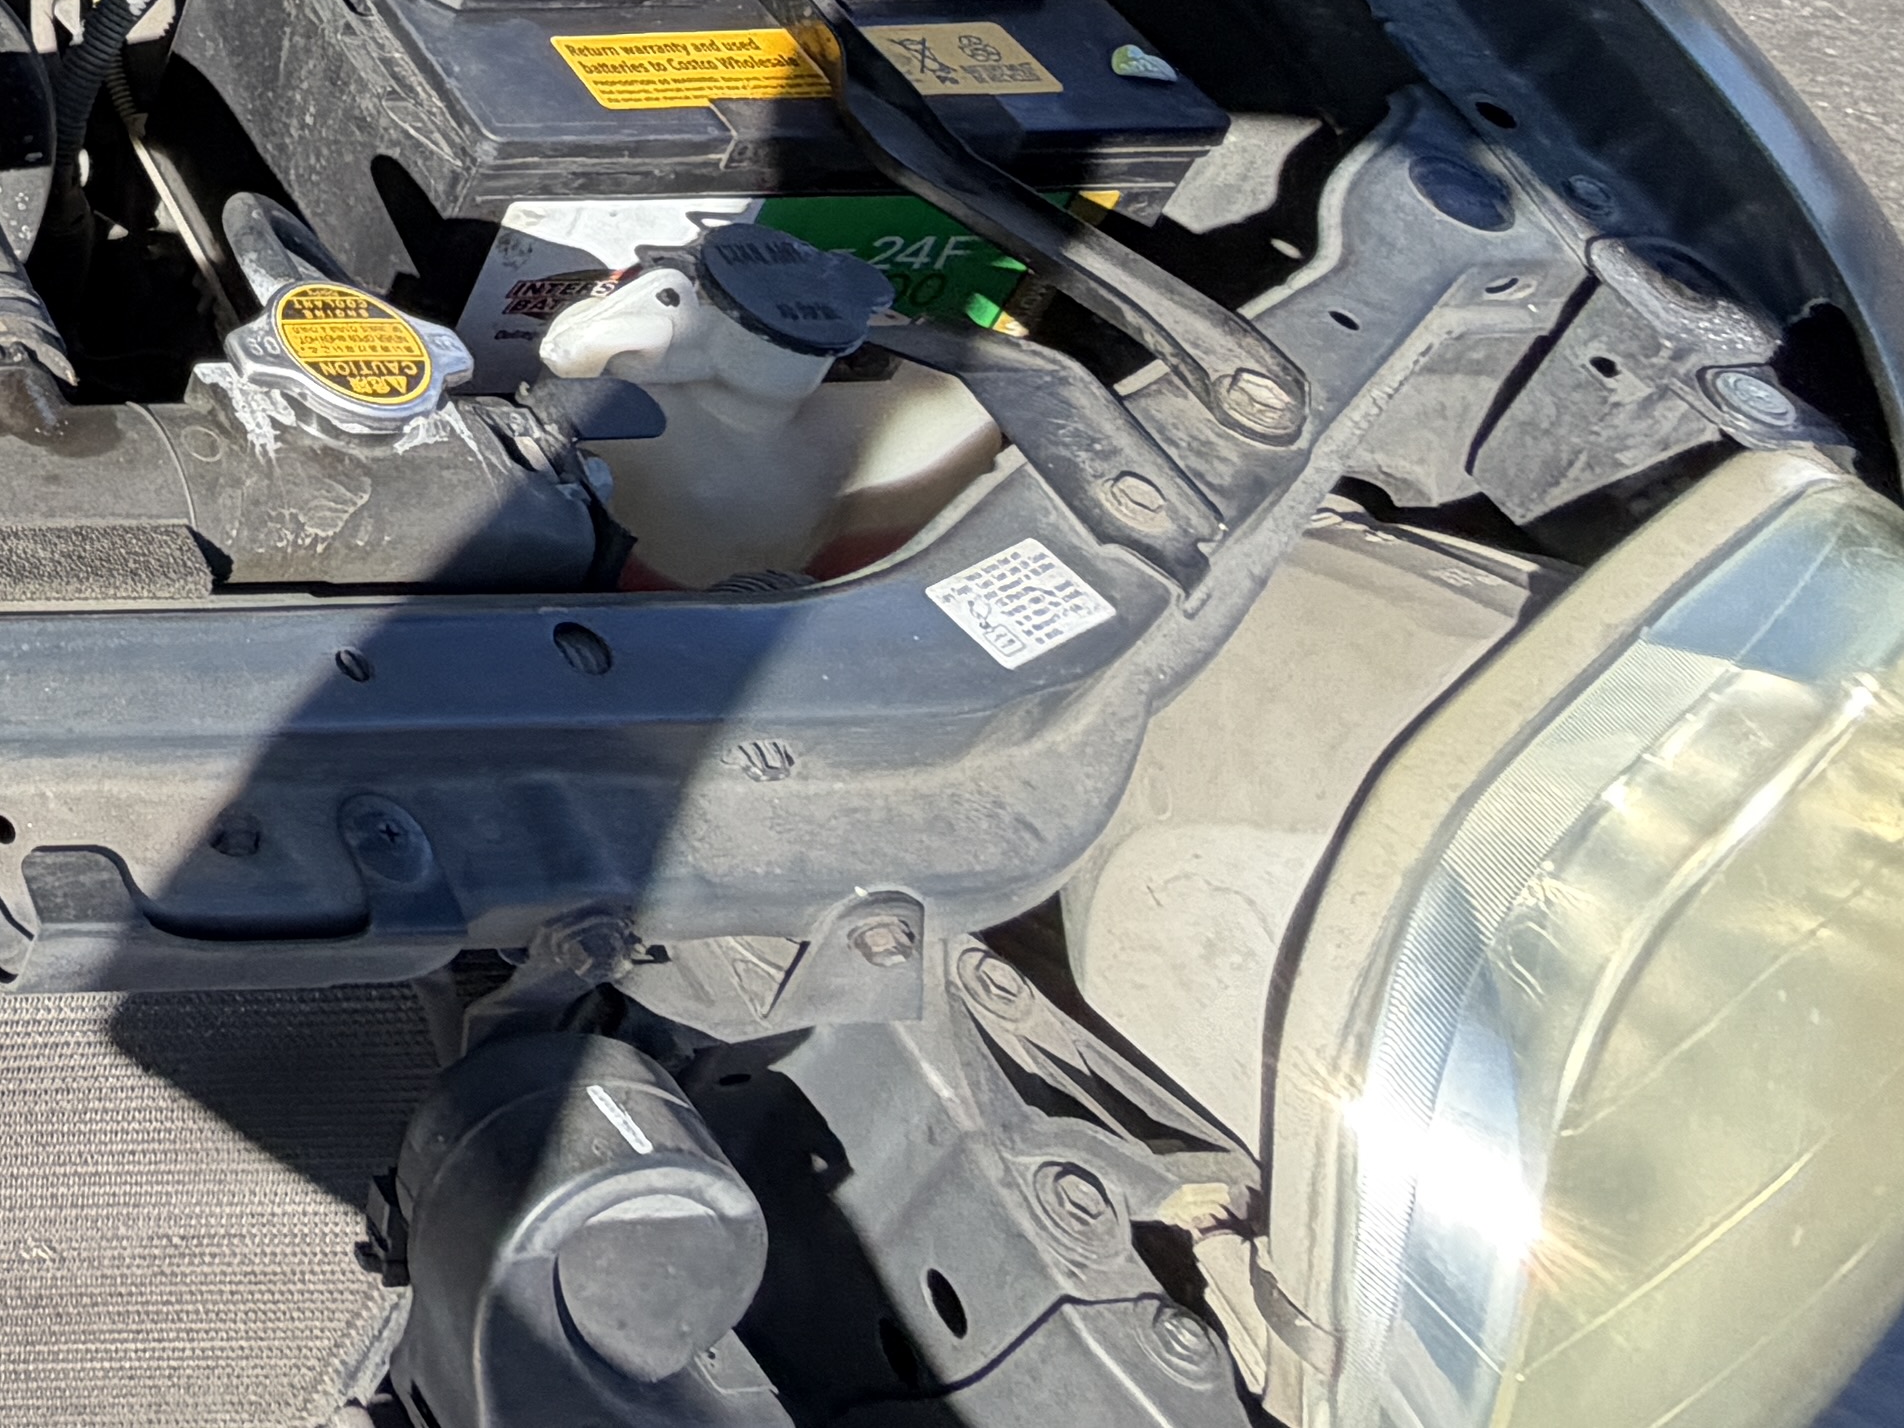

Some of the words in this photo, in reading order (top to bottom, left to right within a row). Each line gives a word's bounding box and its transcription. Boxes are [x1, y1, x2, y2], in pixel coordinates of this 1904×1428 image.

[565, 43, 619, 58] Return
[622, 40, 691, 59] warranty
[693, 38, 721, 53] and
[724, 37, 762, 53] used
[582, 60, 649, 75] batteries
[649, 60, 669, 74] to
[670, 57, 718, 73] Costco
[719, 54, 800, 71] Wholesale
[293, 299, 369, 309] COOLANT
[319, 361, 418, 376] CAUTION
